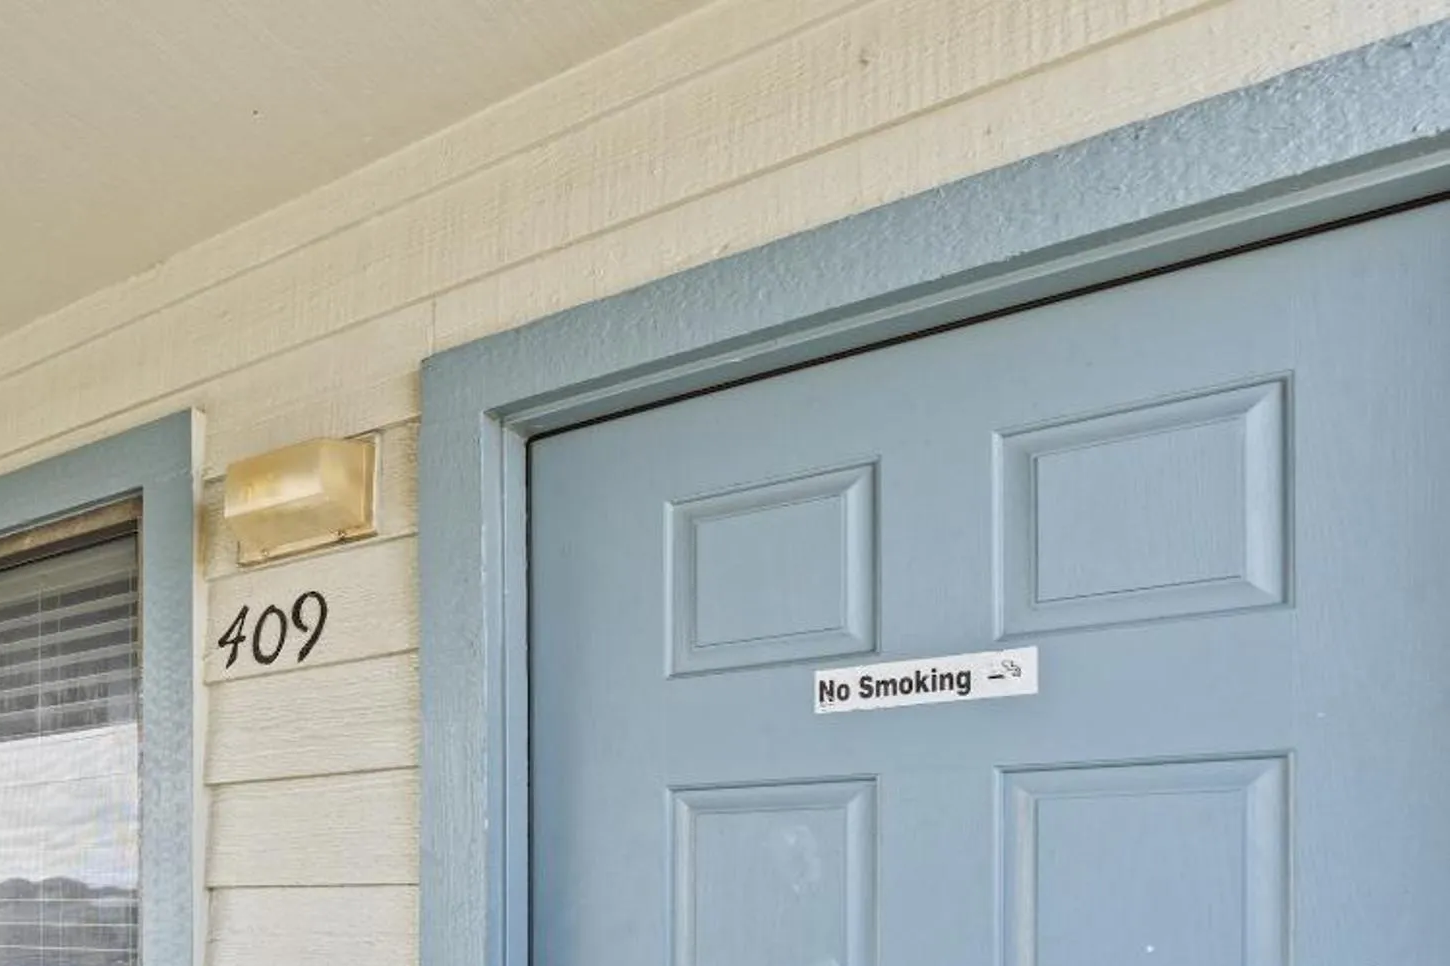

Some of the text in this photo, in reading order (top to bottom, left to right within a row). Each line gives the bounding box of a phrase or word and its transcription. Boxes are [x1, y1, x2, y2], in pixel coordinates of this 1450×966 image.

[218, 591, 328, 669] 409
[818, 668, 971, 702] No Smoking
